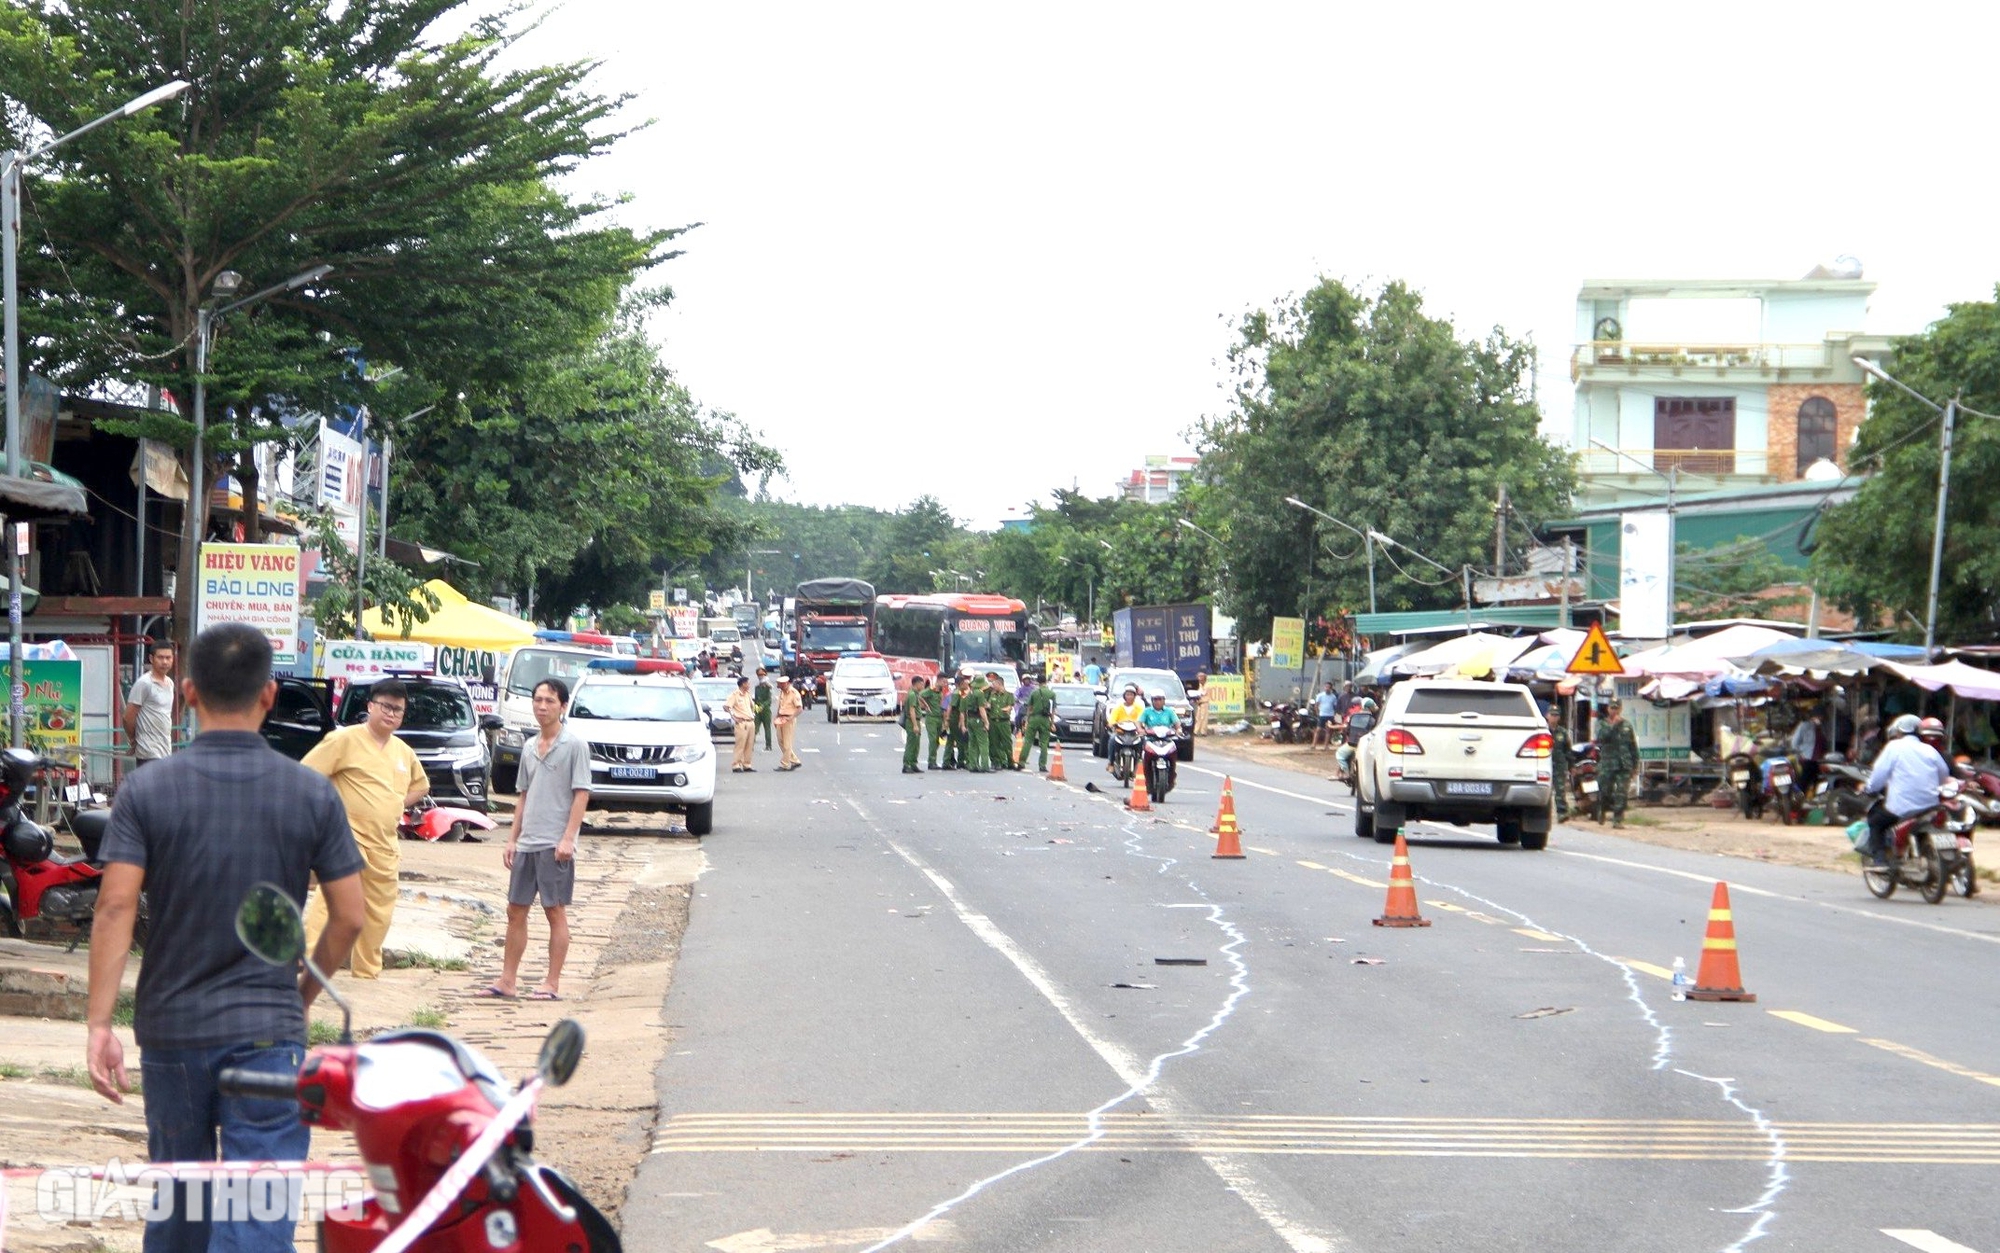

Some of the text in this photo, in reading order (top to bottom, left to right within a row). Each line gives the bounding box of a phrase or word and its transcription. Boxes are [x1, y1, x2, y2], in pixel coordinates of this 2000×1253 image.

[205, 550, 295, 573] HIỆU VÀNG
[206, 575, 294, 596] BẢO LONG
[958, 619, 1017, 632] QUANG VINH
[1181, 615, 1196, 628] XE
[332, 646, 417, 660] CỬA HÀNG
[1179, 644, 1201, 658] BÁO
